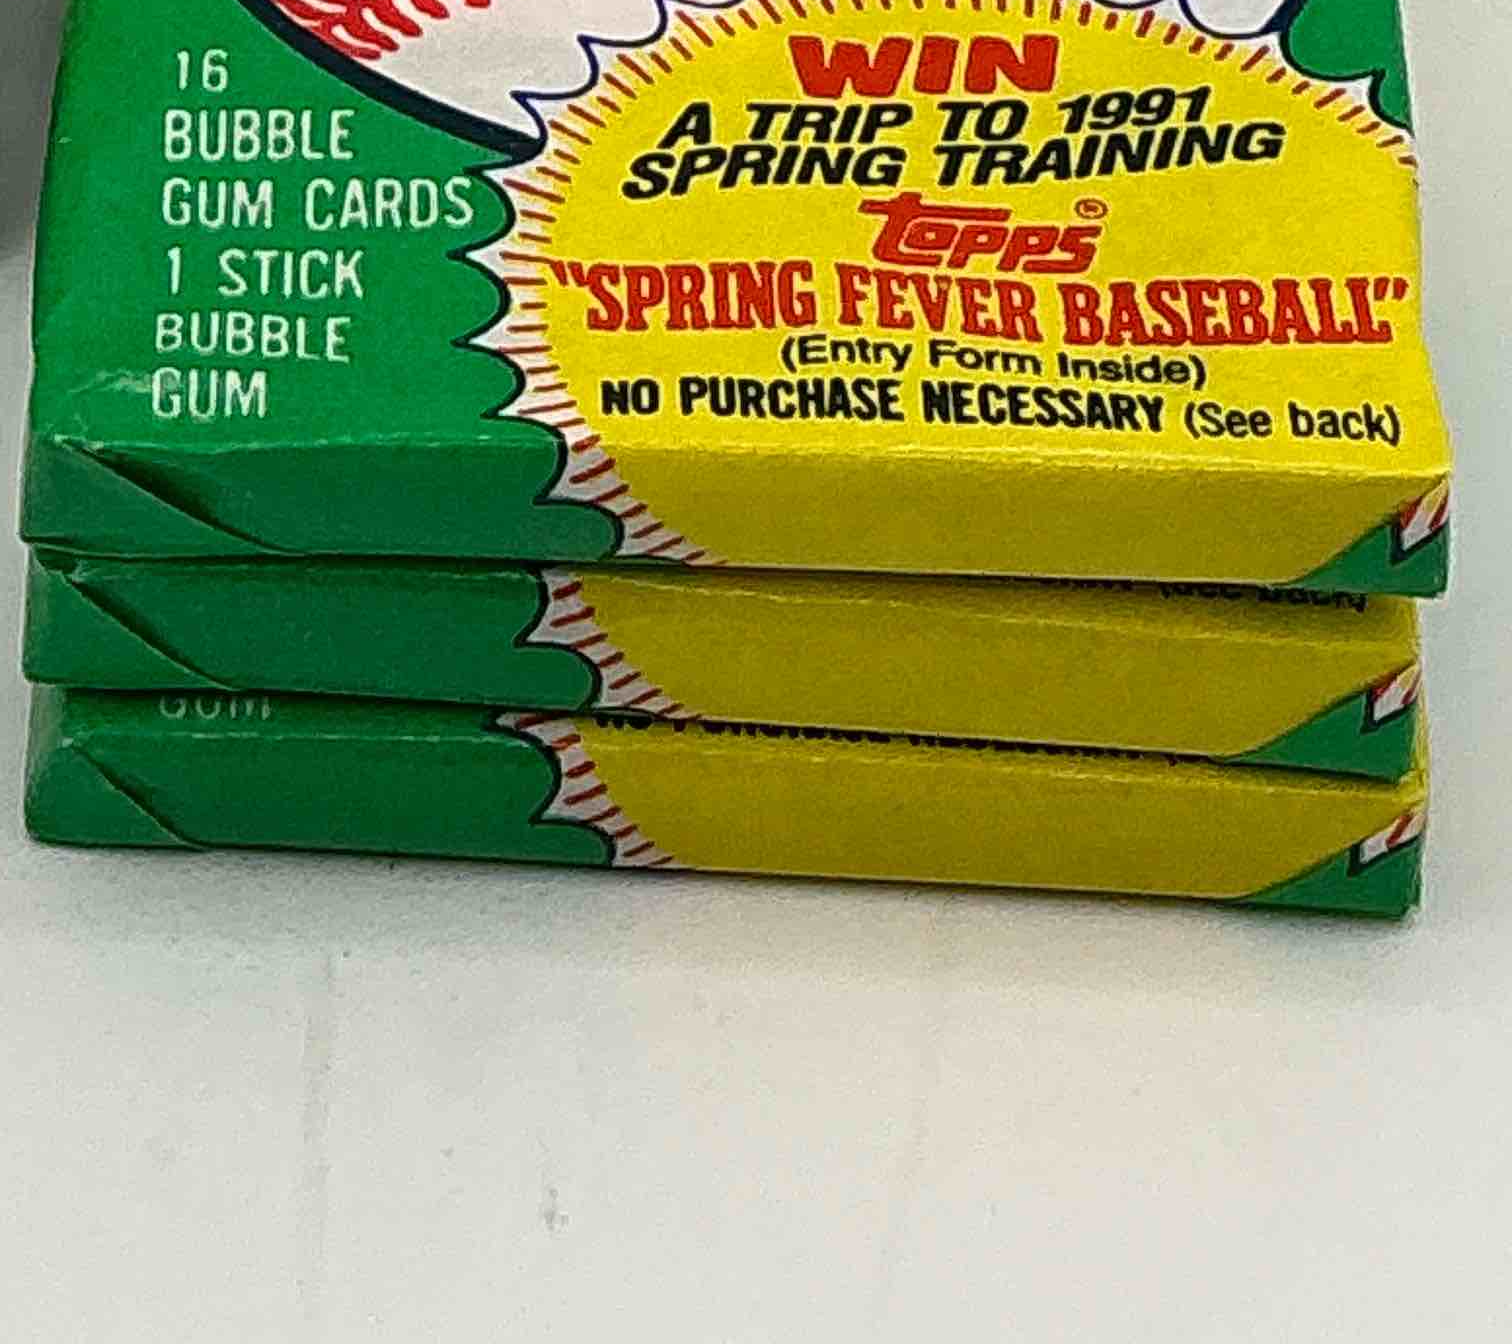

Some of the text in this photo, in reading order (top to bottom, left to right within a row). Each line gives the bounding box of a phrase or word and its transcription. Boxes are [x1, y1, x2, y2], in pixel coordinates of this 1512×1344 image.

[177, 48, 228, 92] 16
[788, 33, 1059, 98] WIN
[164, 109, 355, 161] BUBBLE
[657, 85, 1211, 148] A TRIP TO 1991
[621, 123, 1285, 200] SPRING TRAINING
[162, 176, 474, 231] GUM CARDS
[168, 247, 364, 299] 1 STICK
[838, 262, 1037, 340] FEVER
[155, 313, 352, 363] BUBBLE
[780, 334, 1208, 388] (Entry Form Inside)
[151, 367, 268, 420] GUM
[600, 378, 1401, 445] NO PURCHASE NECESSARY (See back)
